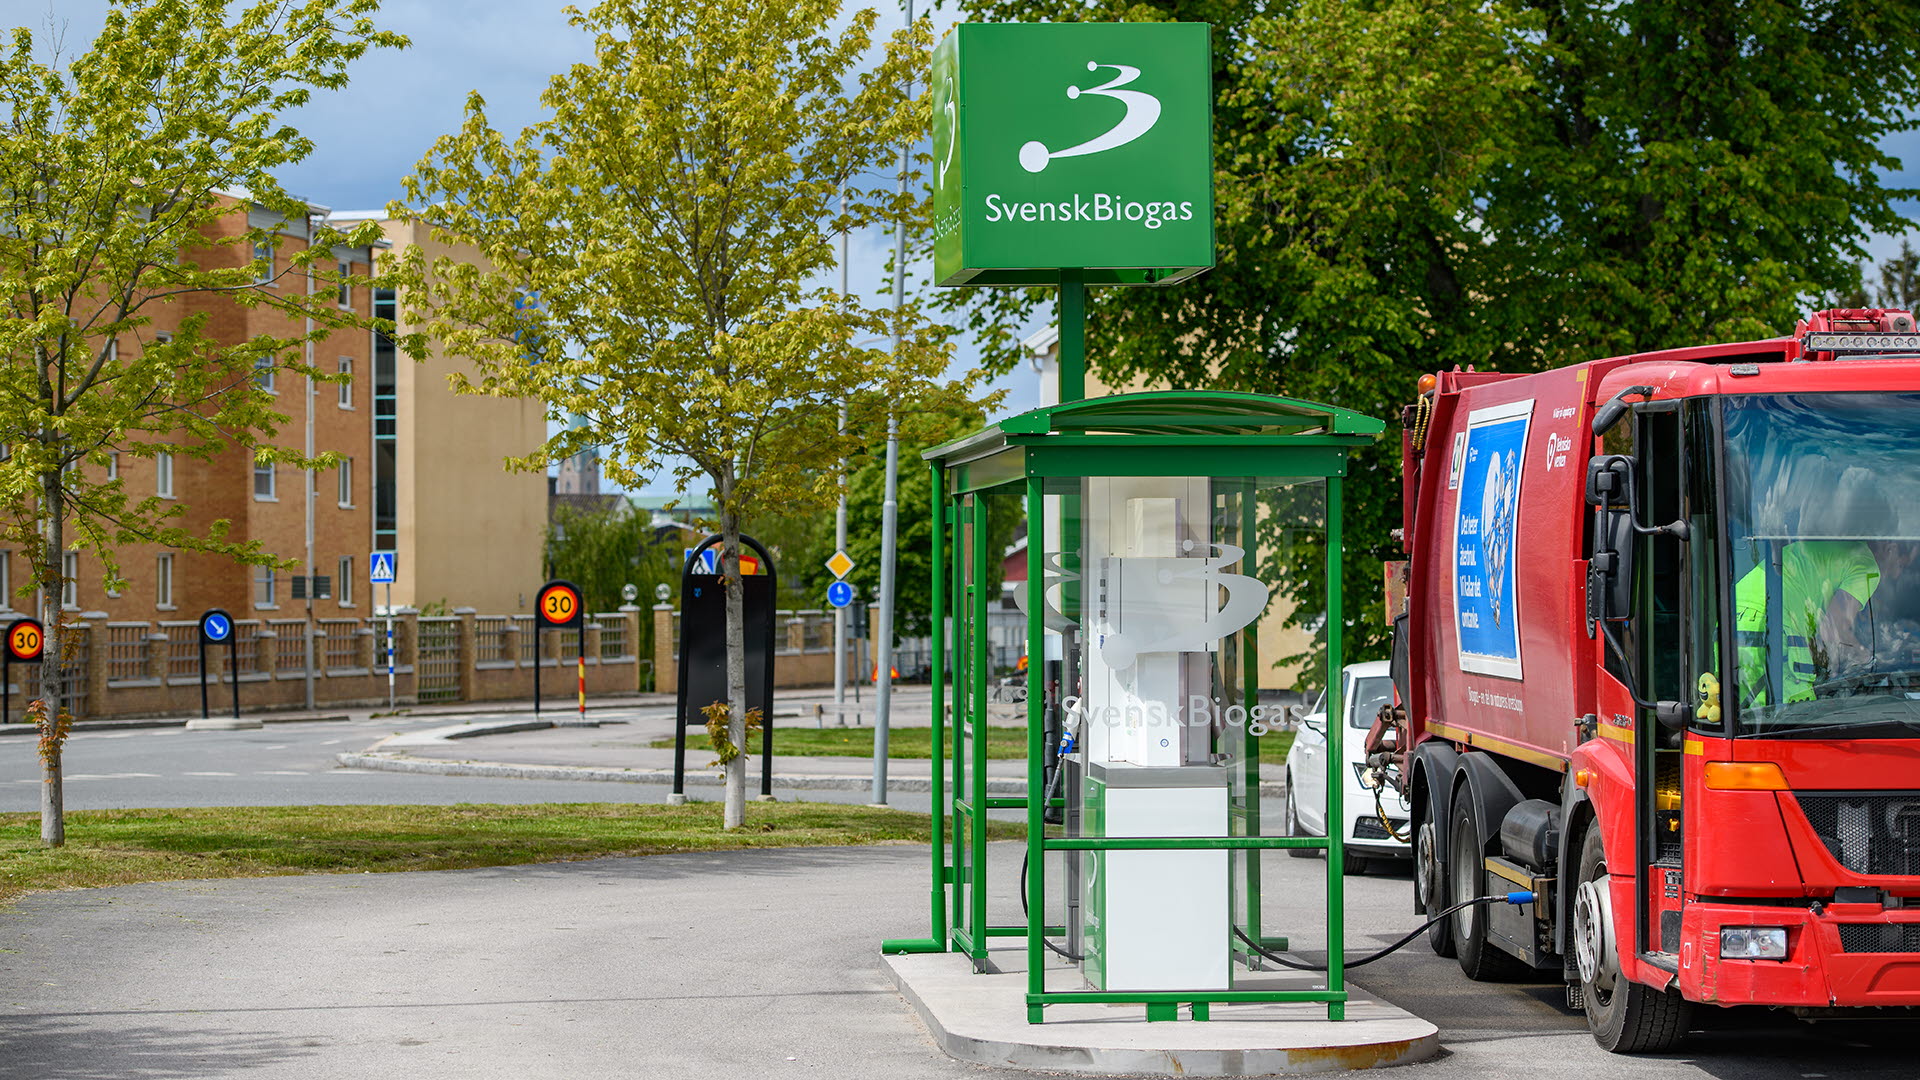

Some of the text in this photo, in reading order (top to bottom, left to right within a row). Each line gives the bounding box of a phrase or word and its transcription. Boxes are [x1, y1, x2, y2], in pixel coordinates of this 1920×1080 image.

[985, 193, 1193, 229] SvenskBiogas
[548, 596, 571, 613] 30
[16, 632, 38, 649] 30
[1061, 695, 1304, 736] SvenskBiogas
